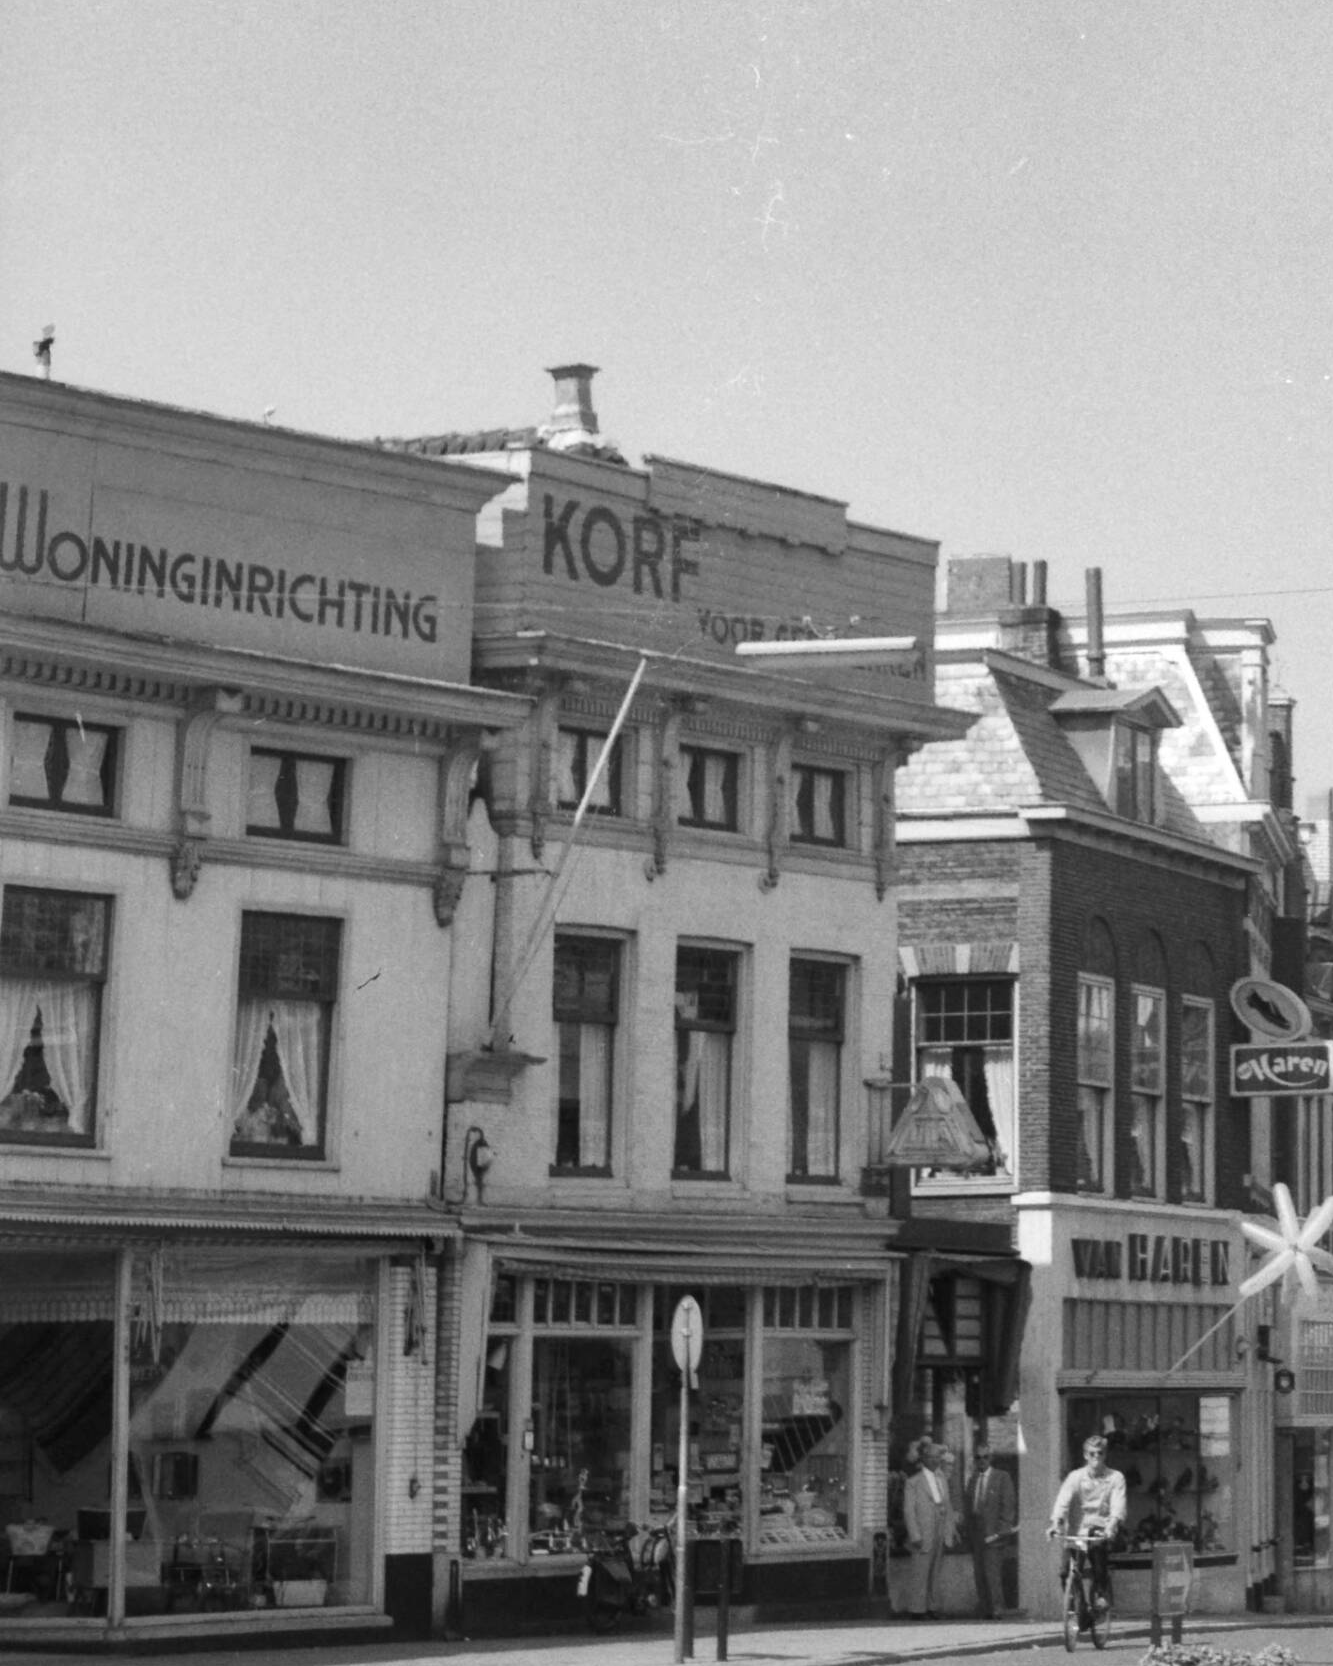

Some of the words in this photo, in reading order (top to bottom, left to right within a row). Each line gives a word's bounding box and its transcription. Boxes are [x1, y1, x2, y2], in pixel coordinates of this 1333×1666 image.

[543, 493, 701, 603] KORF
[1071, 1238, 1122, 1280] VAN
[1128, 1233, 1230, 1286] HAREN
